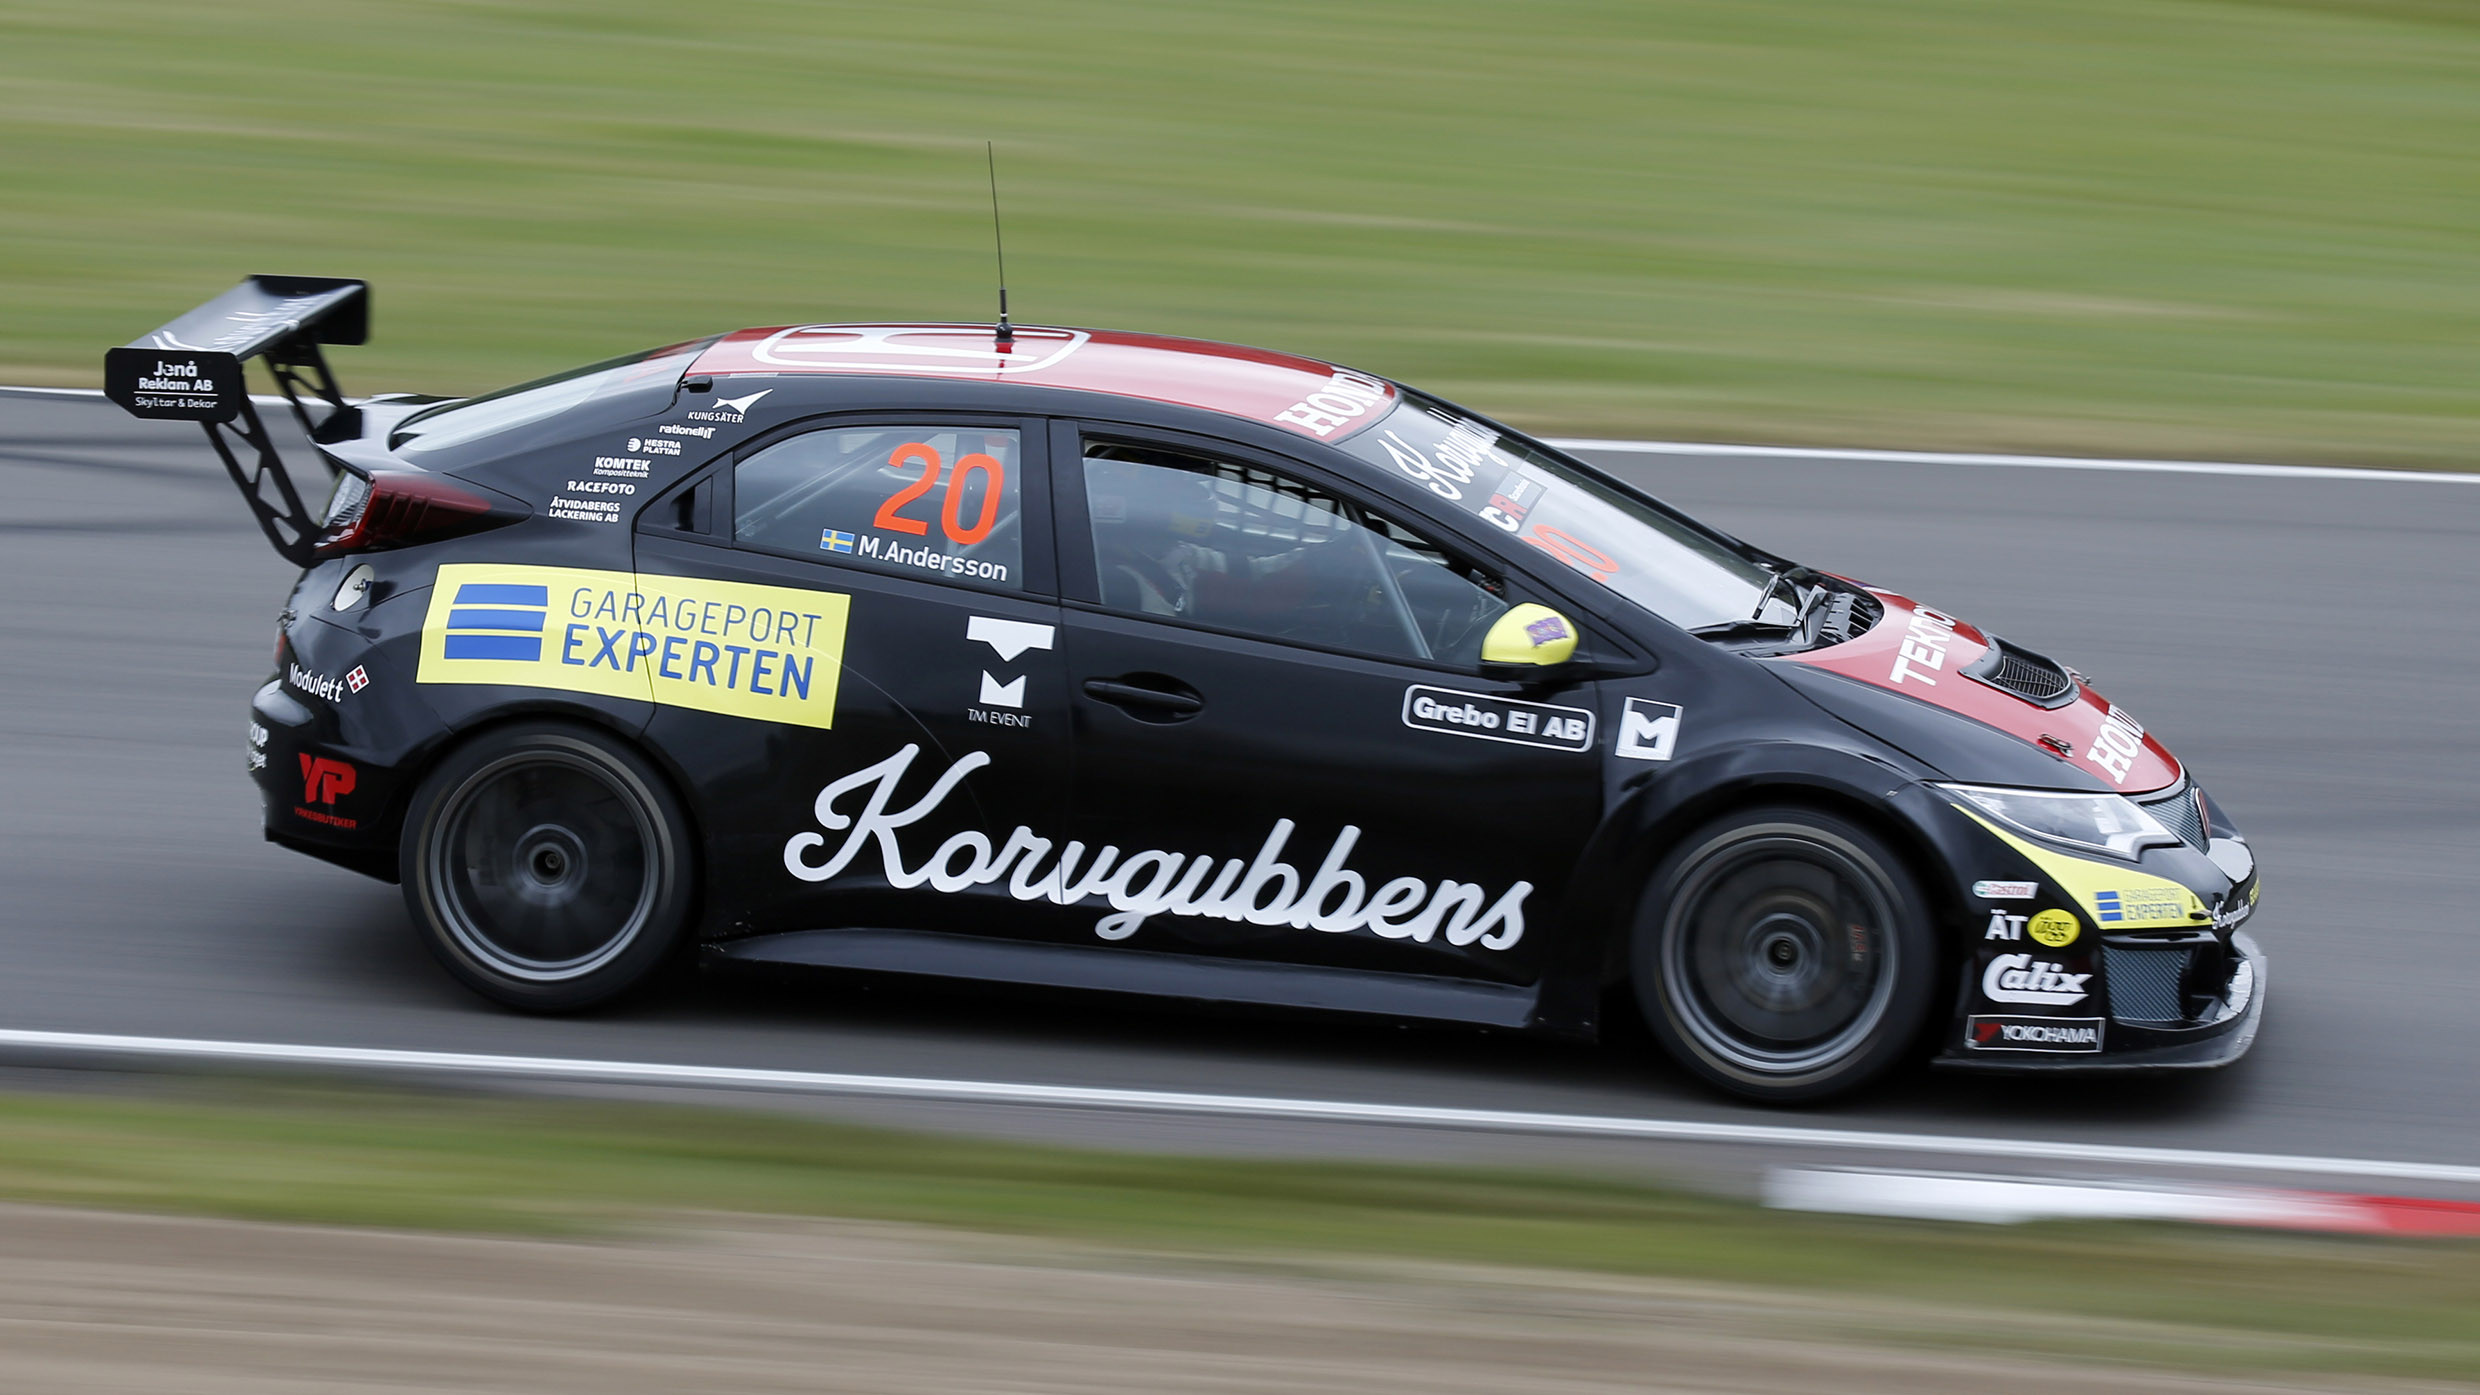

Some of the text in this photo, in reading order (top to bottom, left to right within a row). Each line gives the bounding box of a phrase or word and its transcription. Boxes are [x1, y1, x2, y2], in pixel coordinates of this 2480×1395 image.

[138, 377, 214, 391] Reklam AB
[135, 397, 218, 409] Skyltar & Dekor
[1273, 366, 1386, 437] HOND
[688, 411, 744, 424] KUNGSÄTER
[643, 446, 681, 456] PLATTAN
[644, 439, 682, 449] HESTRA
[595, 456, 651, 471] KOMTEK
[593, 468, 649, 479] Kompositteknik
[567, 481, 635, 495] RACEFOTO
[873, 442, 1005, 545] 20
[550, 496, 620, 512] ÅTVIDABERGS
[549, 508, 619, 523] LACKERING AB
[858, 535, 1007, 582] M.Andersson
[570, 587, 822, 649] GARAGEPORT
[561, 623, 813, 701] EXPERTEN
[289, 662, 343, 703] Modulett
[968, 708, 1032, 728] TM EVENT
[1413, 696, 1500, 729] Grebo
[1542, 715, 1587, 742] AB
[784, 743, 1535, 951] Korvgubbens
[1982, 953, 2093, 1006] Calix
[2000, 1024, 2098, 1043] YOKOHAMA
